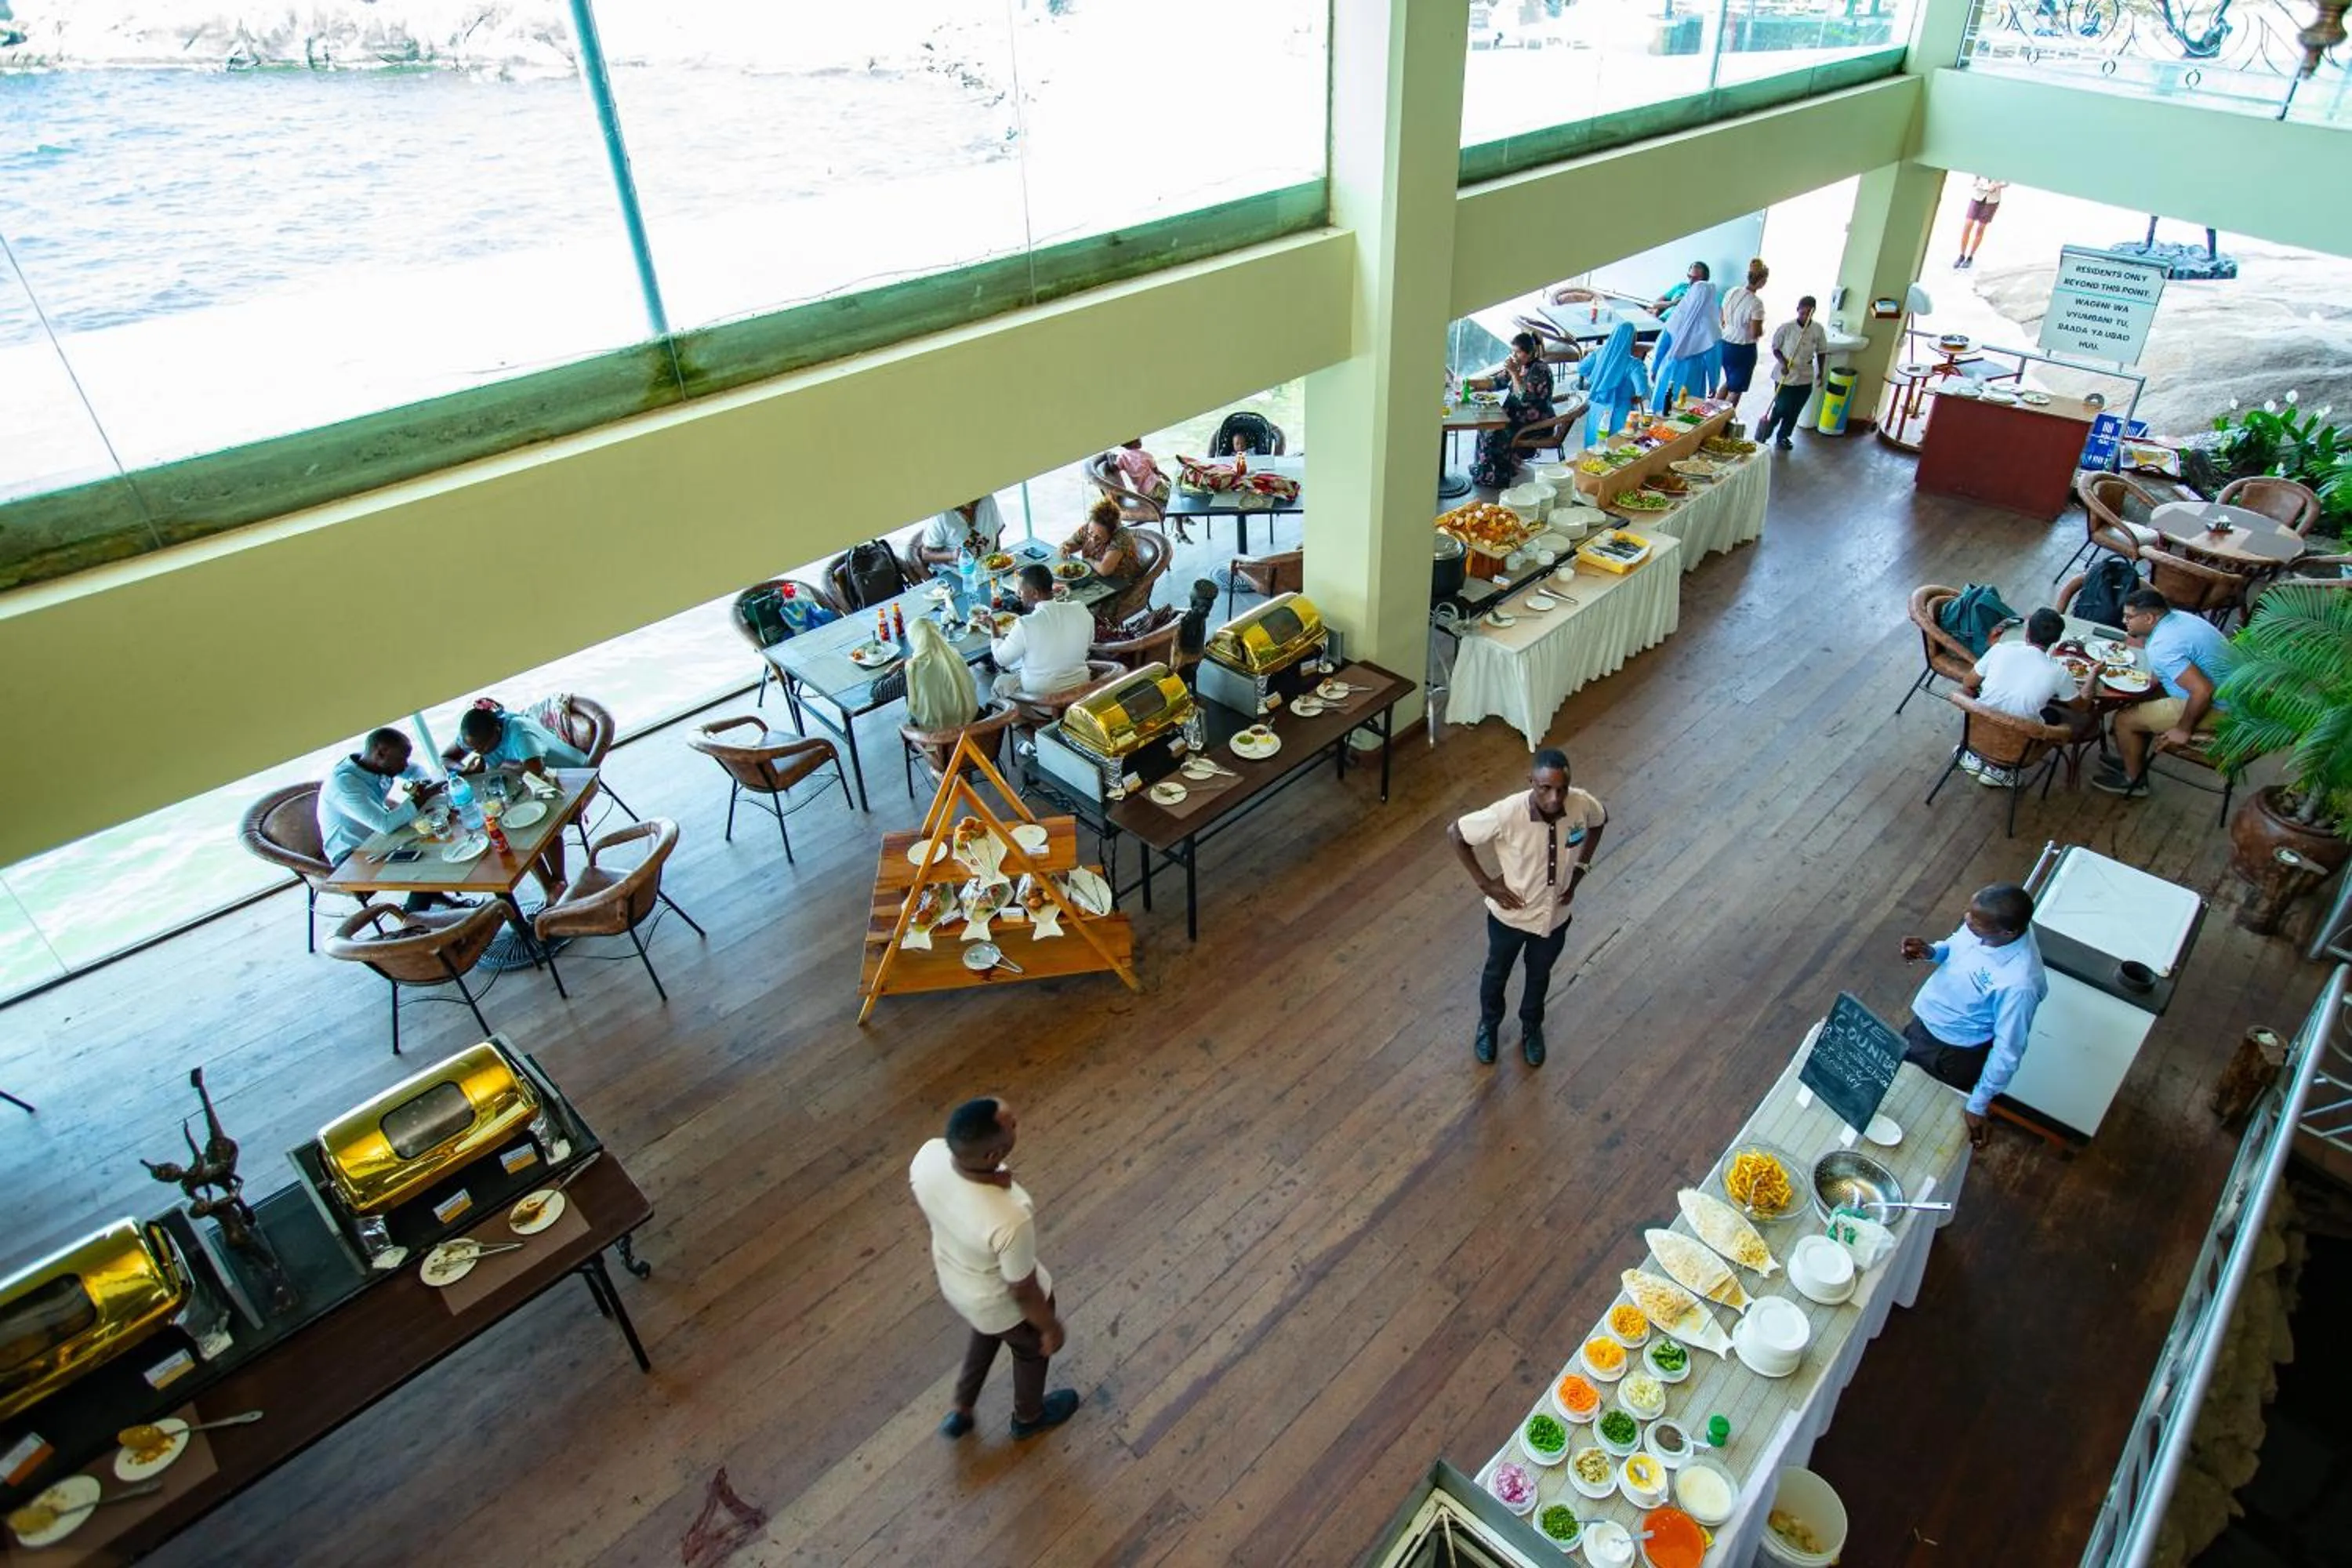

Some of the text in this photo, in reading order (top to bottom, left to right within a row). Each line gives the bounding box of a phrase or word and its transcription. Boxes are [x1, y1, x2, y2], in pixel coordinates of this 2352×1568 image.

[2076, 266, 2147, 281] RESIDENTS ONLY
[2063, 278, 2098, 289] BEYOND
[2101, 284, 2120, 292] THIS
[2075, 299, 2110, 310] WAGENI
[2066, 310, 2113, 324] VYUMBANI
[2057, 323, 2088, 334] BAADA
[2105, 331, 2130, 342] UBAO
[1839, 1000, 1890, 1045] LIVE
